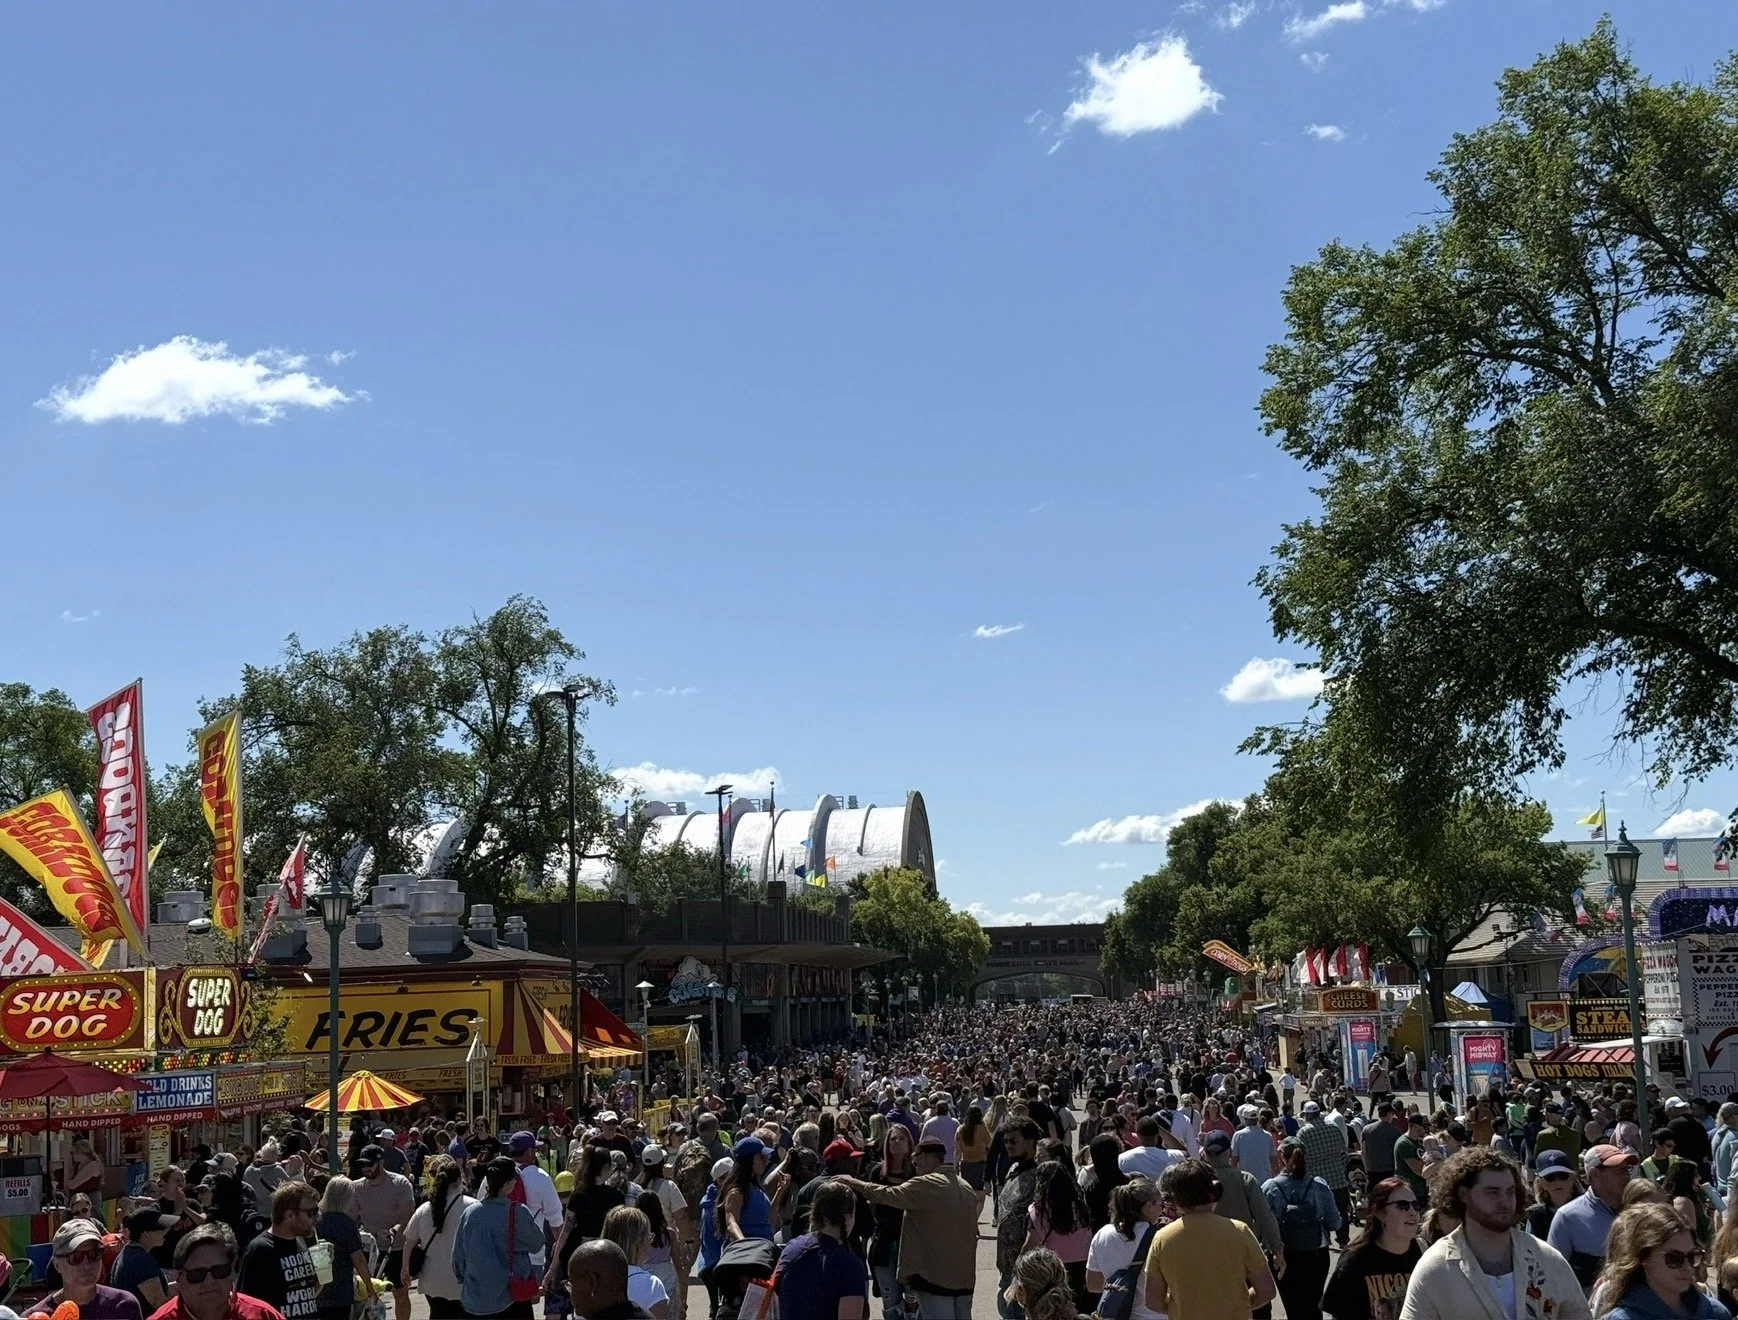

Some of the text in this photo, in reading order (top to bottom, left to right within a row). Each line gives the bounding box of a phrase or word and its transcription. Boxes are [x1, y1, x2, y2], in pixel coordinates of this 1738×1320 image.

[1210, 949, 1247, 972] CORN DOGS
[187, 978, 231, 1008] SUPER
[1331, 992, 1368, 1000] CHEESE
[8, 988, 122, 1015] SUPER
[1331, 1000, 1369, 1008] CURDS
[25, 1014, 107, 1039] DOG
[194, 1007, 224, 1036] DOG
[305, 1009, 478, 1050] FRIES
[1576, 1024, 1647, 1034] SANDWICHS
[385, 1071, 406, 1079] FRIES
[439, 1069, 462, 1078] FRESH
[1534, 1064, 1561, 1077] HOT
[1564, 1064, 1600, 1077] DOGS
[170, 1075, 212, 1092] DRINKS
[1701, 1084, 1734, 1096] $3.00
[138, 1091, 212, 1110] LEMONADE
[62, 1117, 121, 1128] HAND DIPPED
[147, 1111, 203, 1123] HAND DIPPED
[0, 1123, 20, 1131] OGS
[6, 1178, 31, 1188] REFILLS
[7, 1188, 29, 1198] $5.00
